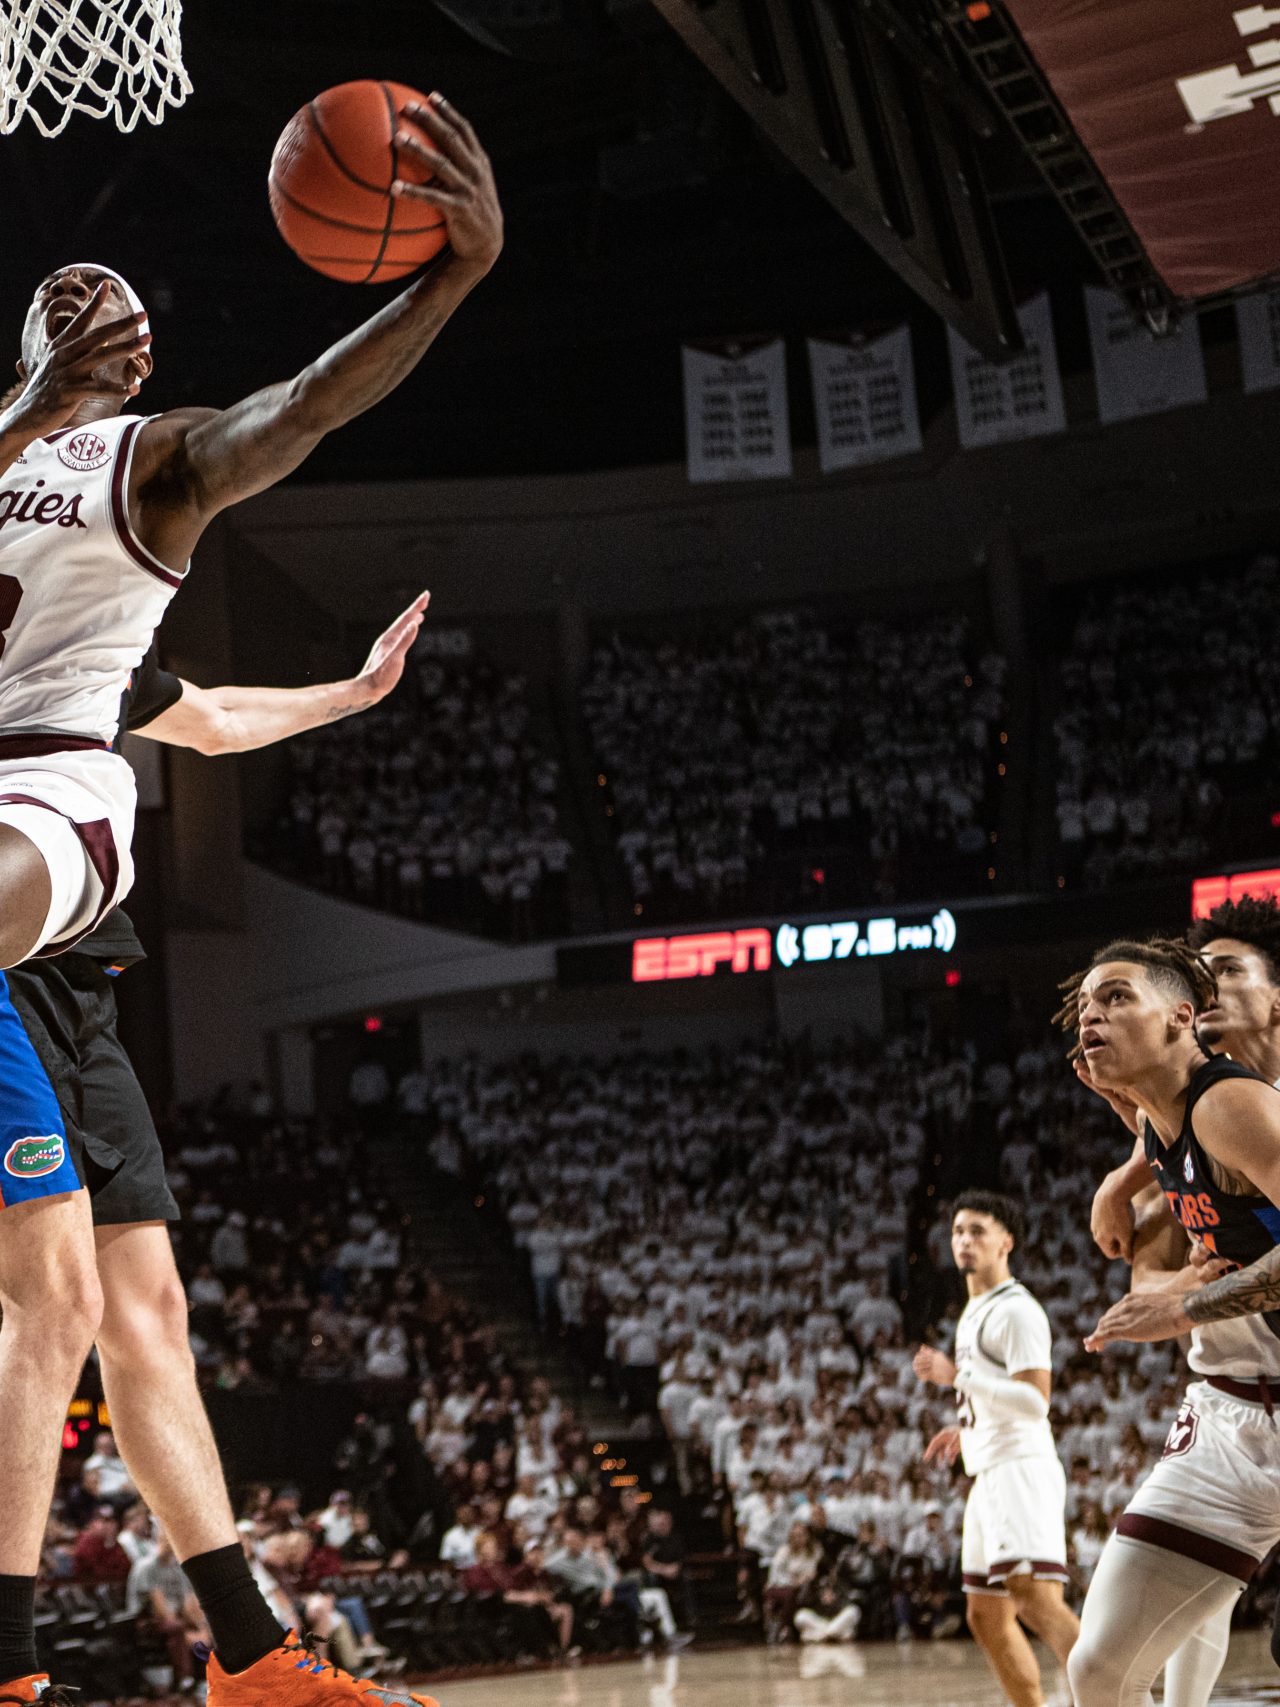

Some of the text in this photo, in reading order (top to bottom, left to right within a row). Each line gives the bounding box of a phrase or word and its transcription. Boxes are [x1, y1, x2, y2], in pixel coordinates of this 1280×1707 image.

[70, 433, 106, 461] SEC
[62, 454, 103, 471] GRADUATE
[632, 928, 770, 982] ESPN
